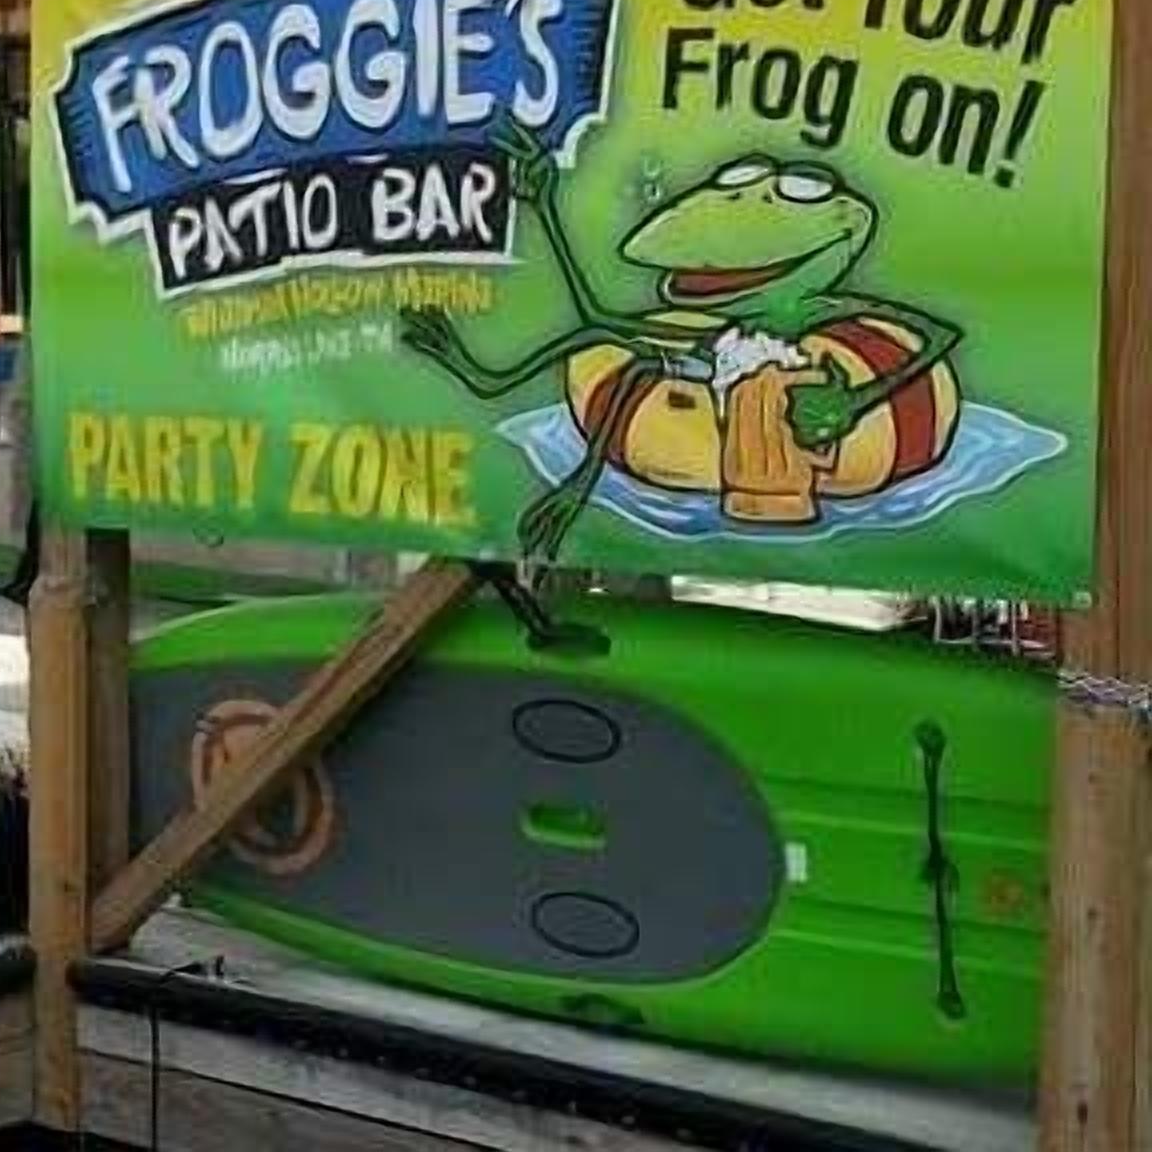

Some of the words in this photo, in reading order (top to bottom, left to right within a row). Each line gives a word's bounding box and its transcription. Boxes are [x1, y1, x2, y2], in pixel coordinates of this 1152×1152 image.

[661, 26, 860, 150] Frog
[885, 73, 1045, 190] on!
[168, 173, 340, 279] PATIO
[370, 162, 497, 244] BAR
[67, 412, 265, 509] PARTY
[288, 422, 478, 526] ZONE
